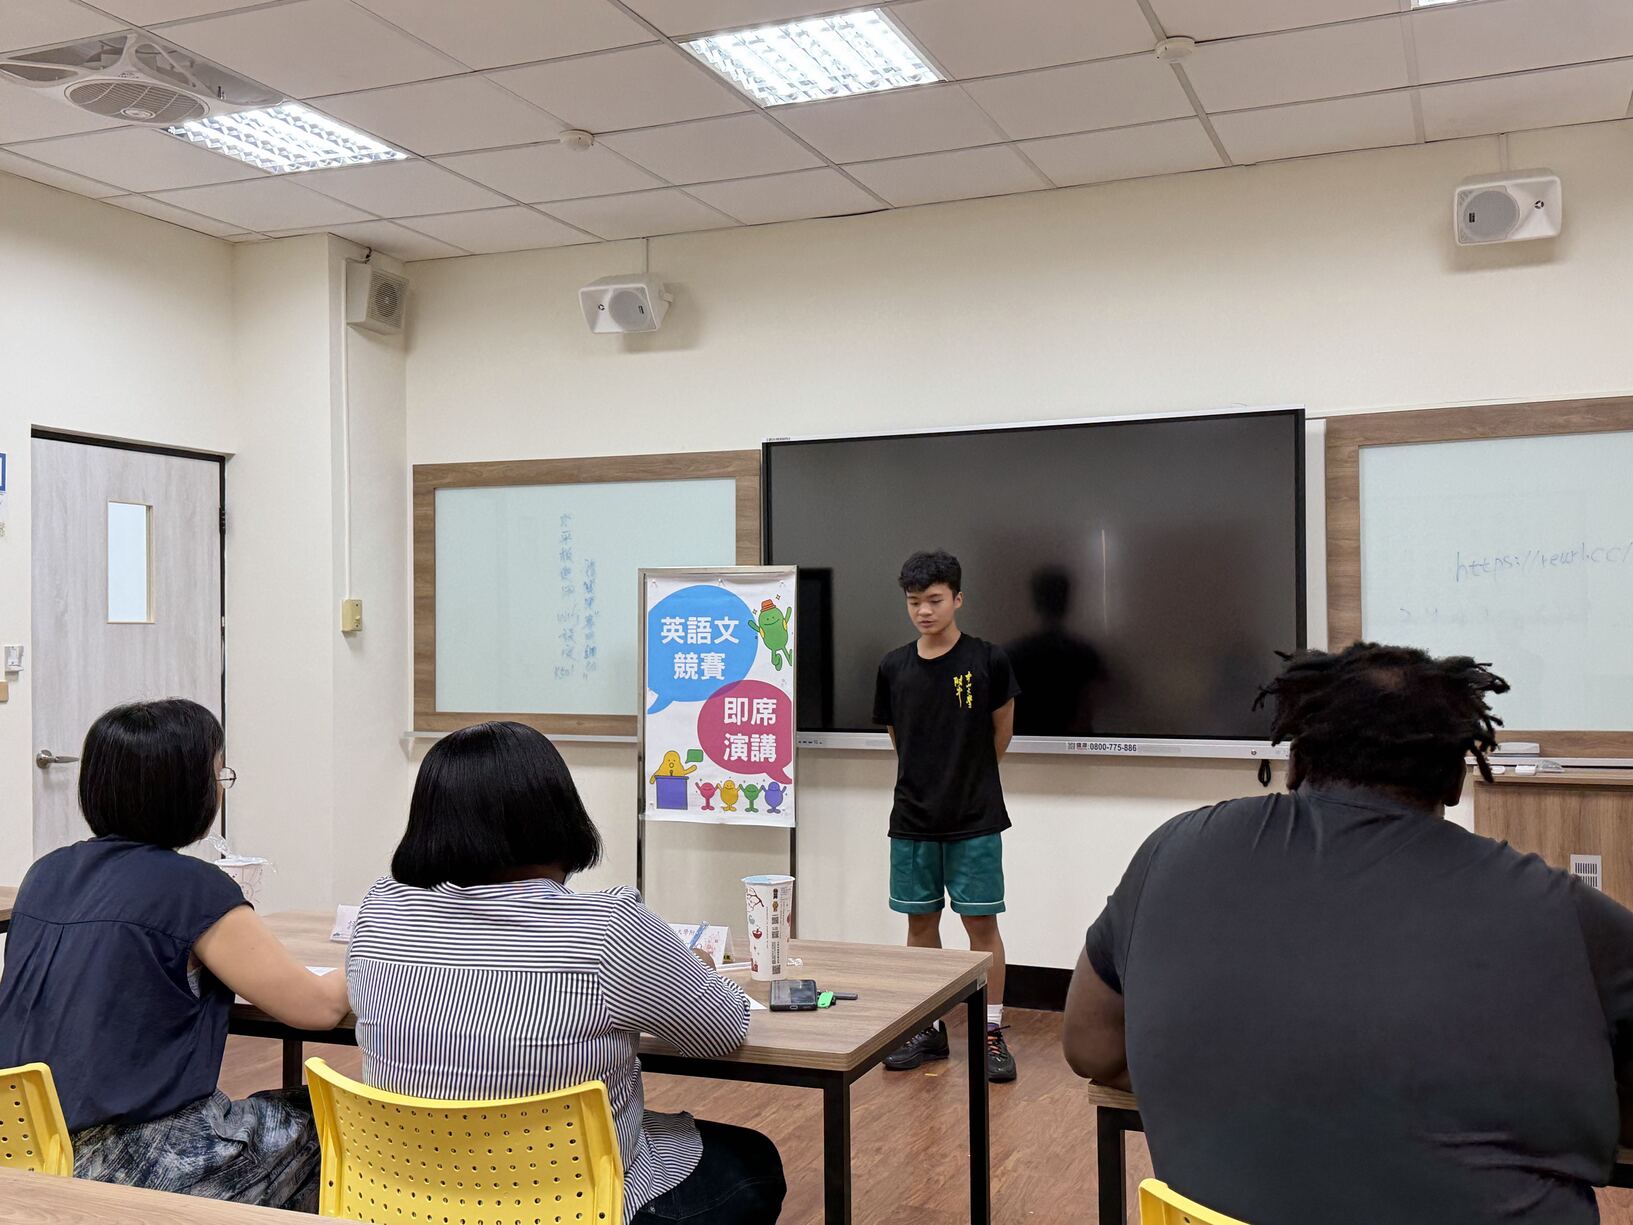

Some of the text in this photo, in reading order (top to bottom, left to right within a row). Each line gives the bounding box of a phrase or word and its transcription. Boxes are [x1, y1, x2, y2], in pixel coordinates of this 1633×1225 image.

[660, 616, 740, 645] 英語文
[673, 652, 726, 680] 競賽
[723, 697, 777, 726] 即席
[723, 733, 777, 762] 演講
